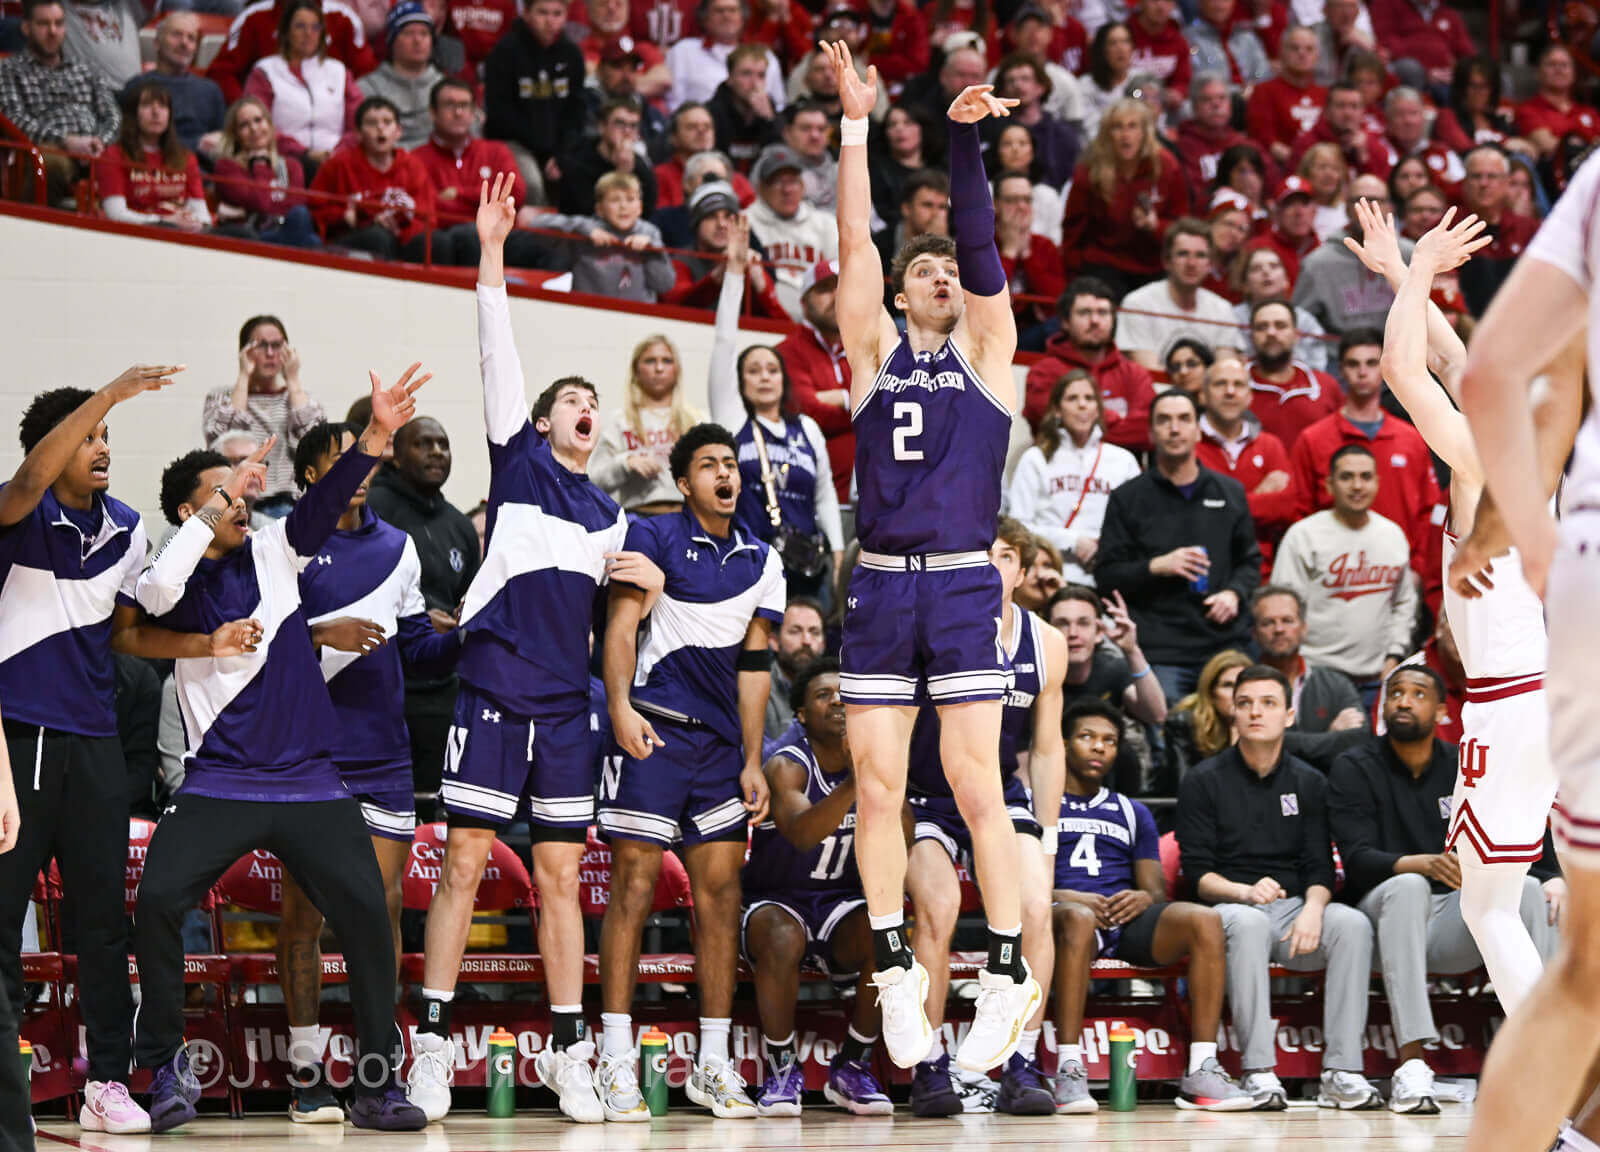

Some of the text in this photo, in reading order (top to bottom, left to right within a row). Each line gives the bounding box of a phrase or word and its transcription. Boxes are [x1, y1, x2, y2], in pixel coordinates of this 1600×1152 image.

[893, 402, 924, 461] 2
[910, 555, 921, 571] N
[443, 724, 469, 773] N
[599, 755, 624, 801] N
[810, 833, 854, 880] 11
[1069, 834, 1103, 876] 4
